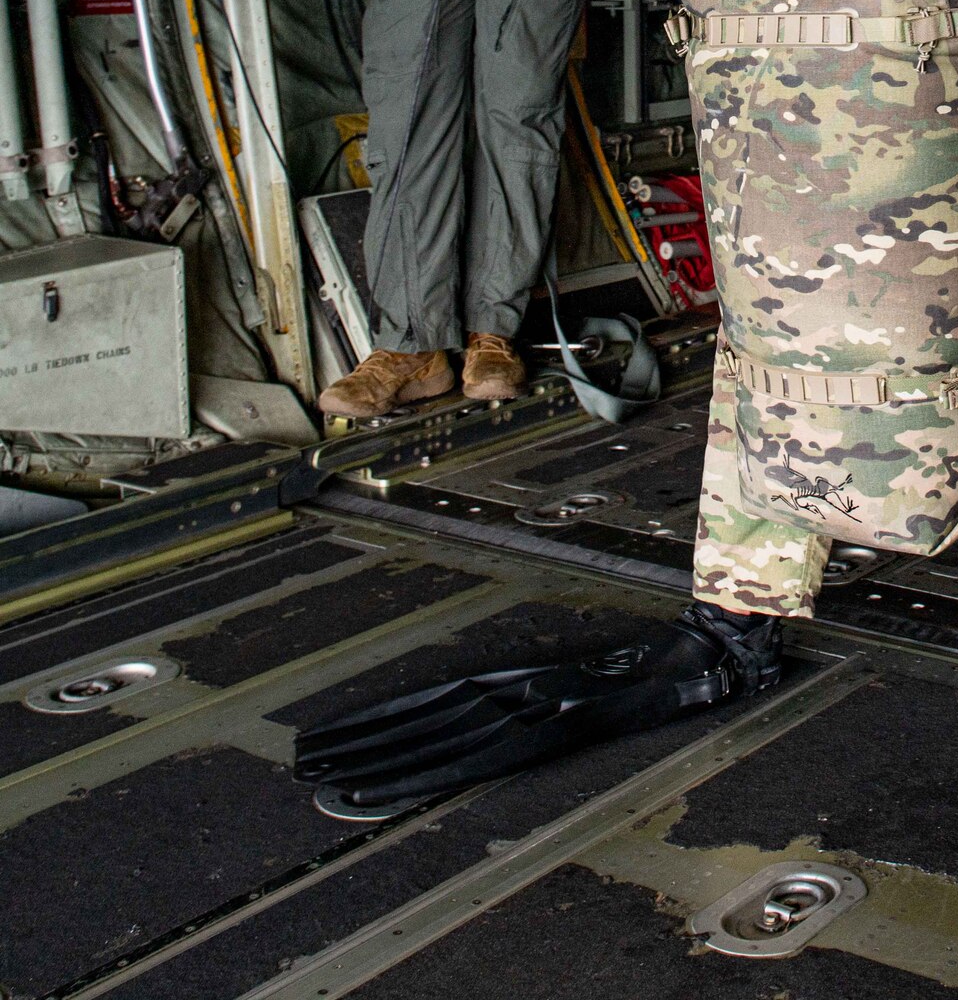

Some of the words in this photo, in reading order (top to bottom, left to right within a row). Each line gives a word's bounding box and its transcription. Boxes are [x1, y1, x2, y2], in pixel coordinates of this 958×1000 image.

[24, 362, 38, 374] LB
[45, 353, 90, 370] TIEDOWN
[96, 346, 131, 360] CHAINS
